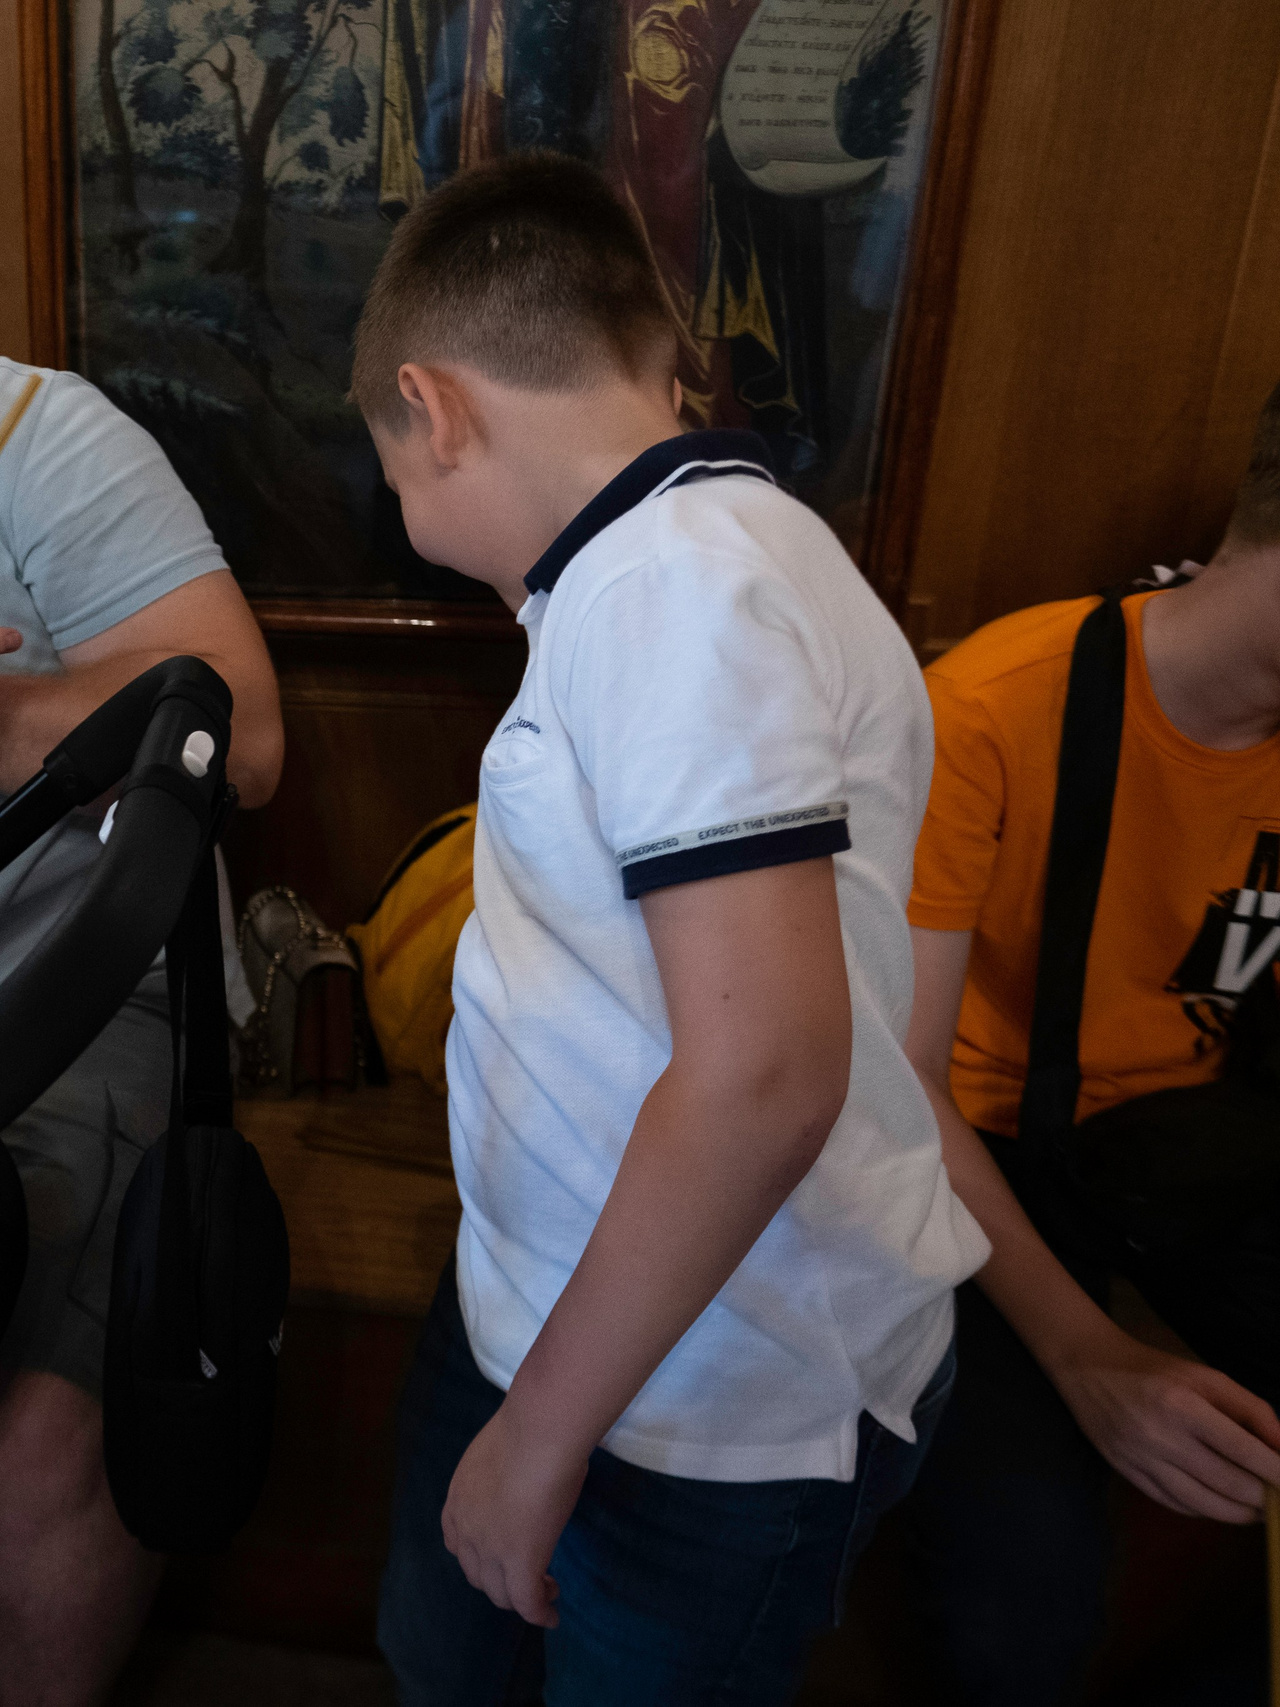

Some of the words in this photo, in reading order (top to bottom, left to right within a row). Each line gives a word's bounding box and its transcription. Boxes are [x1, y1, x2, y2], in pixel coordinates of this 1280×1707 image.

[698, 823, 740, 840] EXPECT
[743, 818, 767, 830] THE
[768, 807, 830, 825] UNEXPECTED
[628, 837, 679, 857] UNEXPECTED
